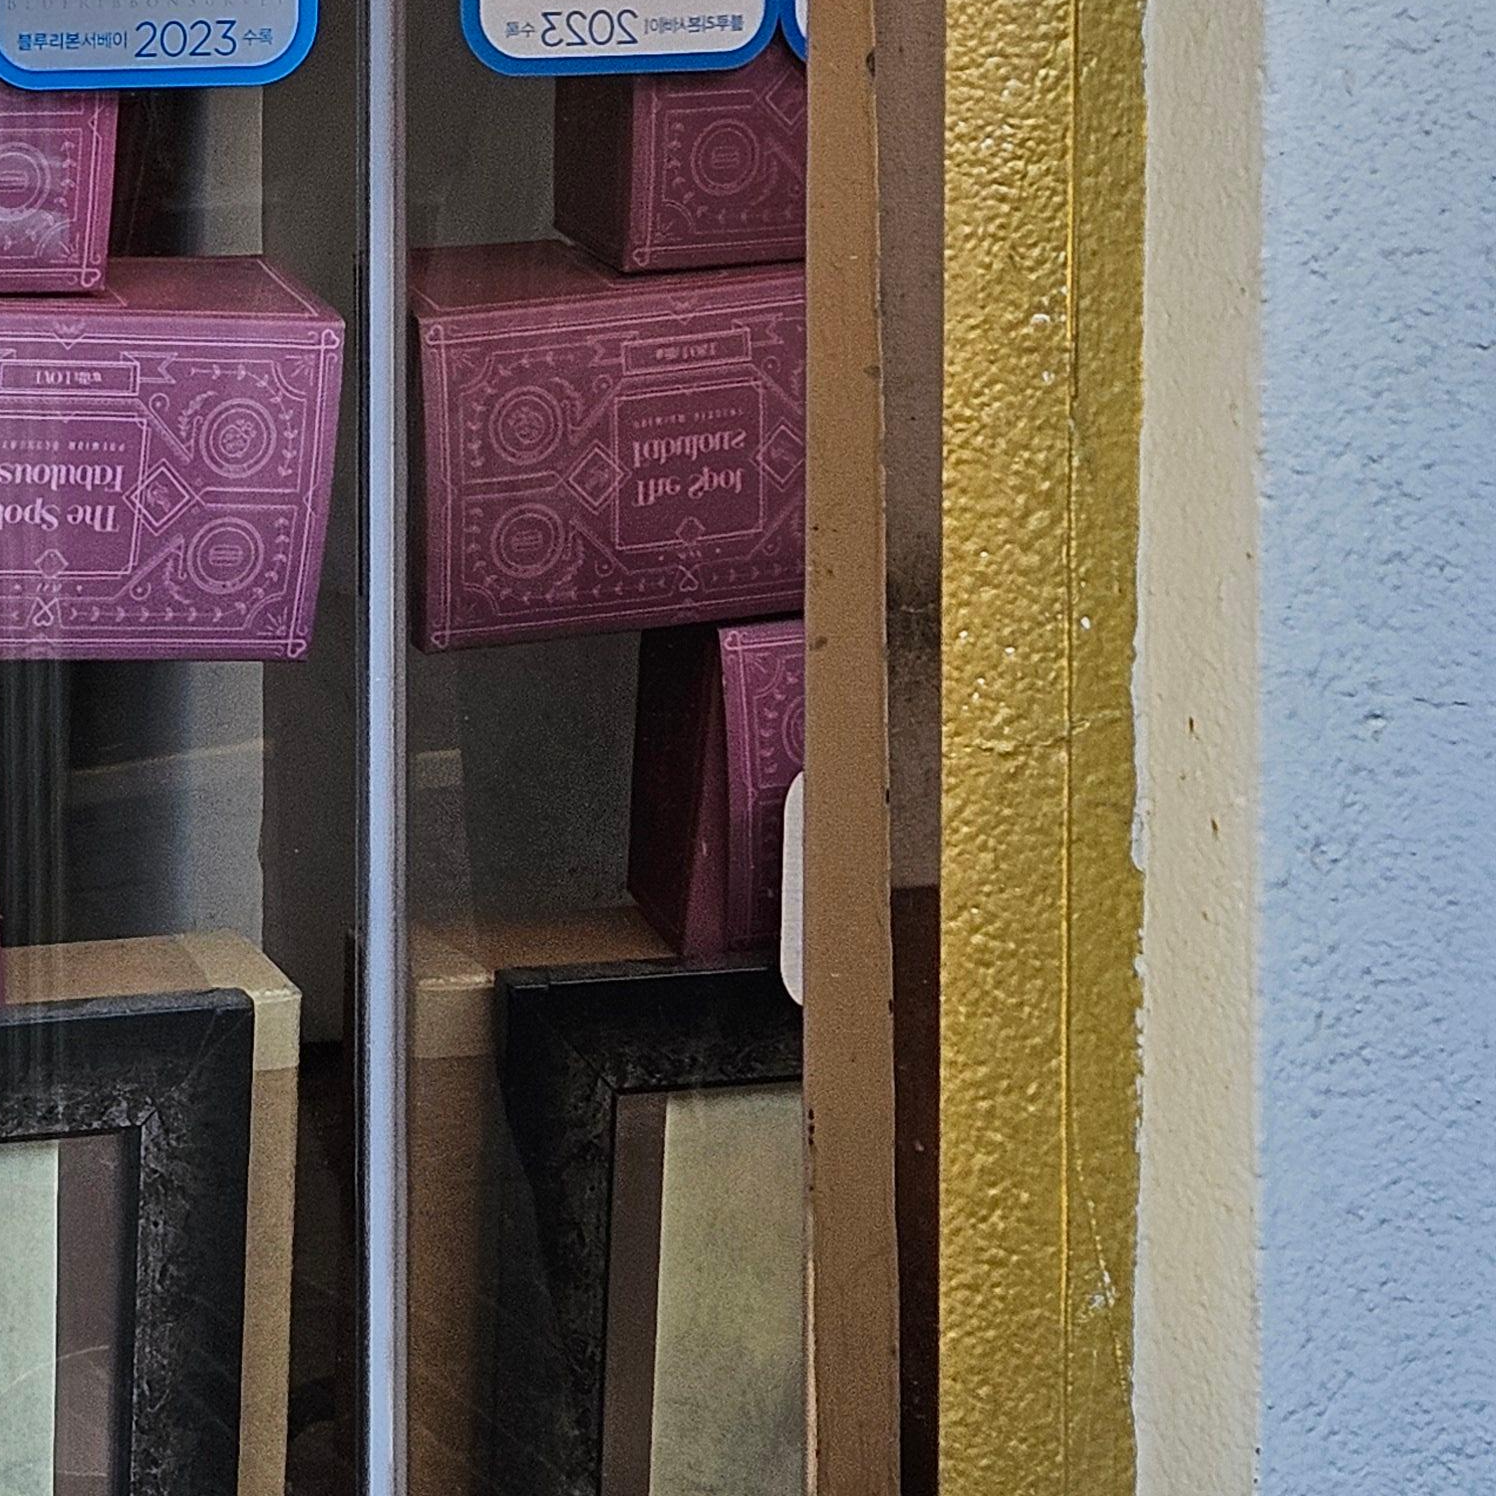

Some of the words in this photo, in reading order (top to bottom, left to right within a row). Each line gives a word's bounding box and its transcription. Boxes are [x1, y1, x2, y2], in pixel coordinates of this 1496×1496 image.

[17, 32, 128, 52] 블루리본서베이
[134, 19, 238, 58] 2023
[242, 27, 274, 46] 수록
[66, 503, 120, 534] The
